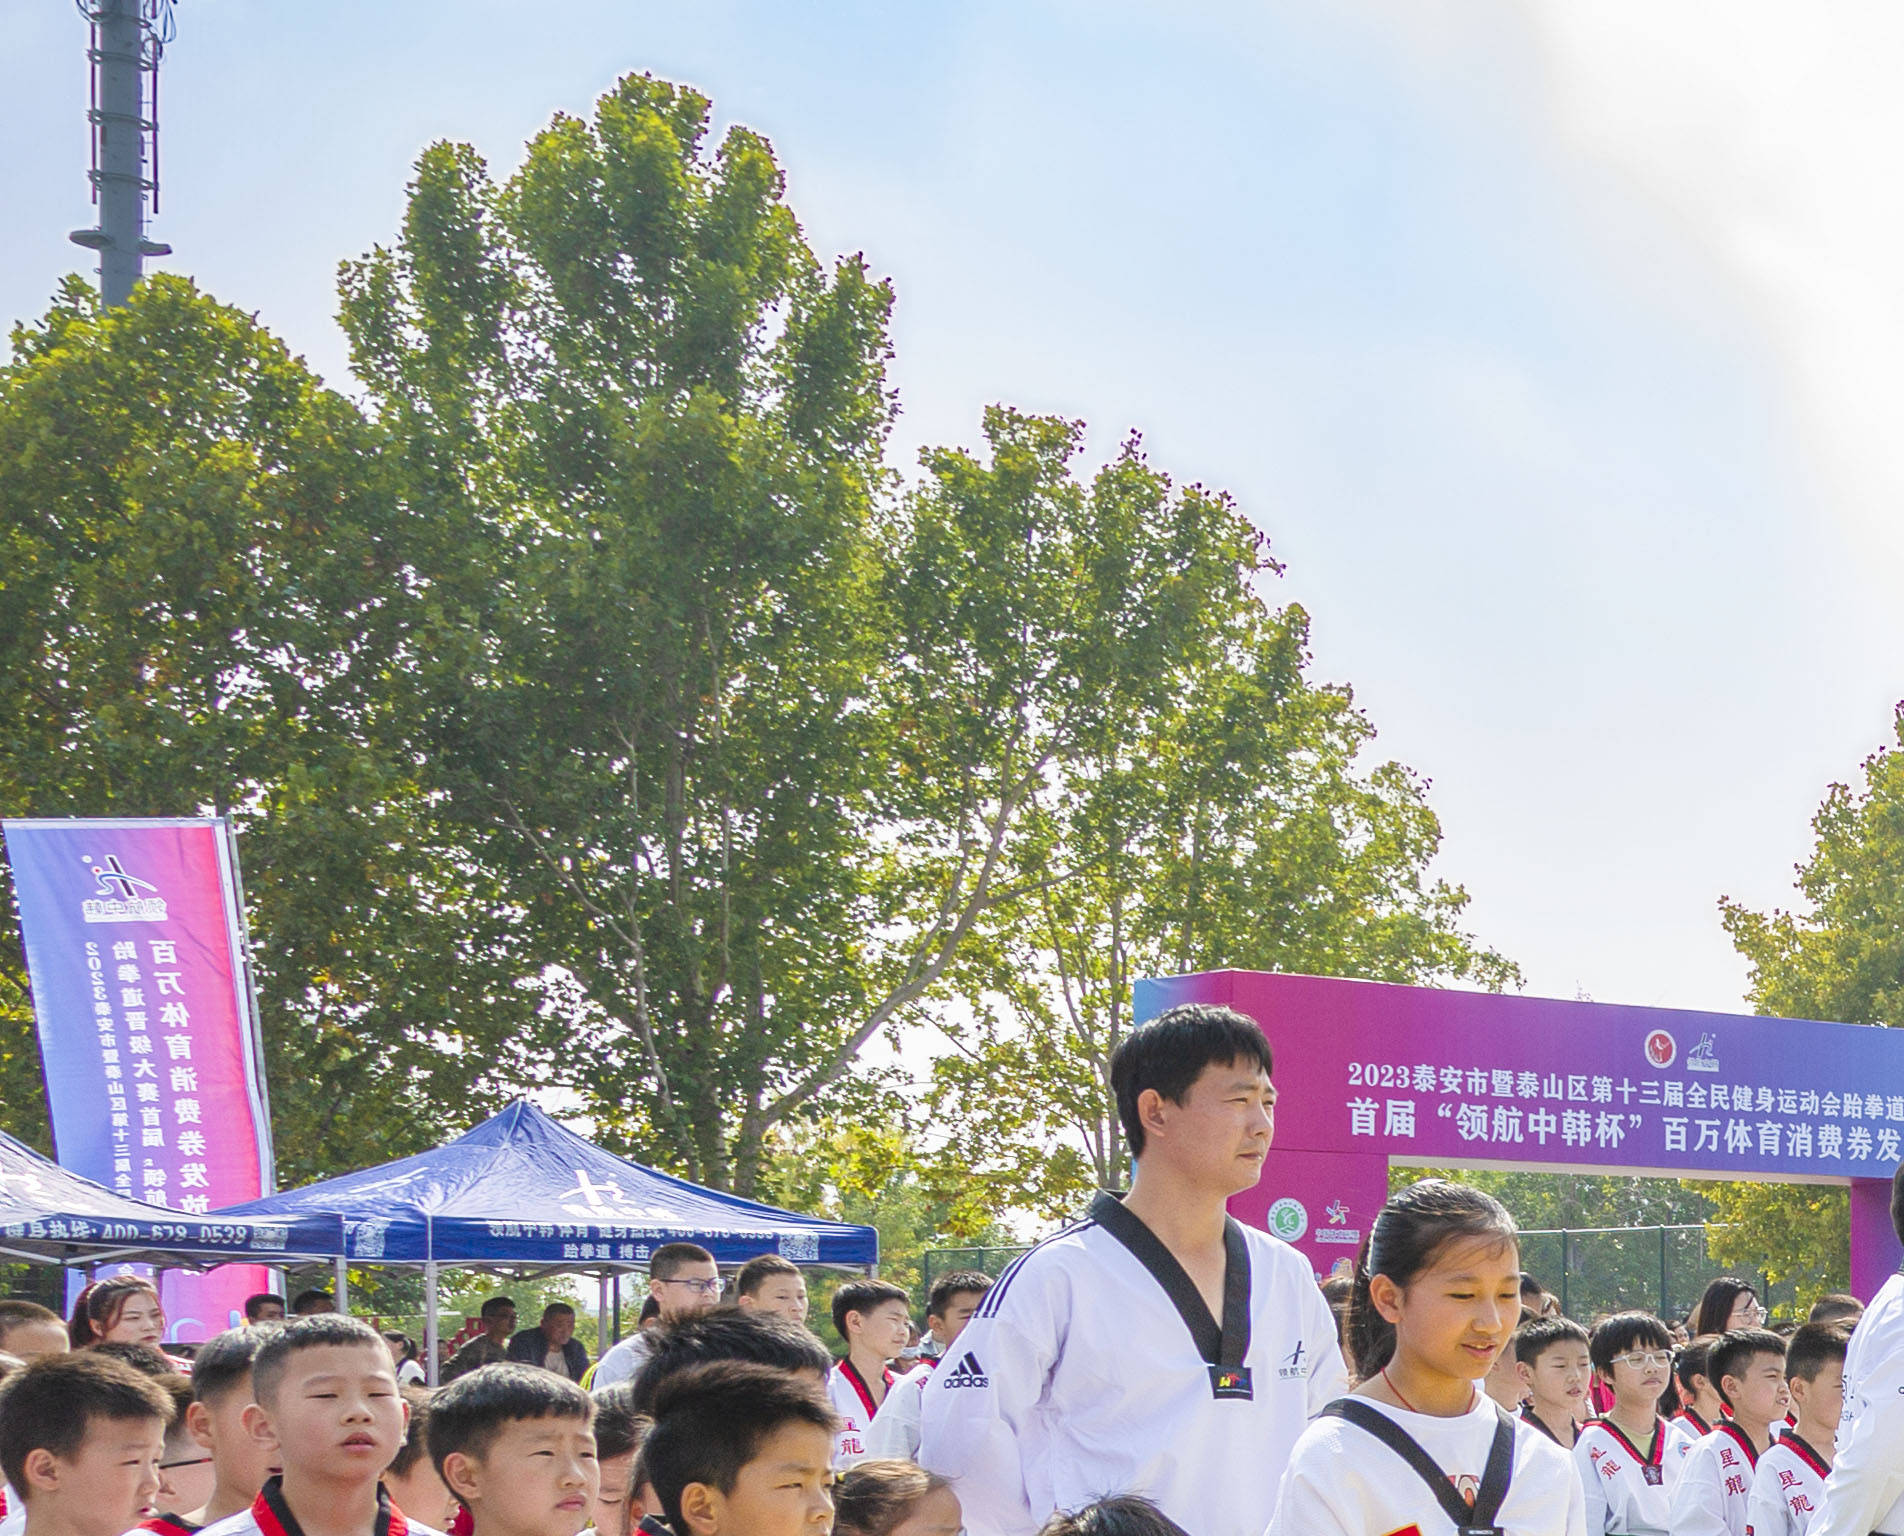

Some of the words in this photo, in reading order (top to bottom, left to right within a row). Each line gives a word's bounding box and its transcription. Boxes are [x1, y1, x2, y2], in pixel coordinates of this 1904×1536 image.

[564, 1244, 611, 1259] 跆拳道
[943, 1375, 989, 1389] adidas
